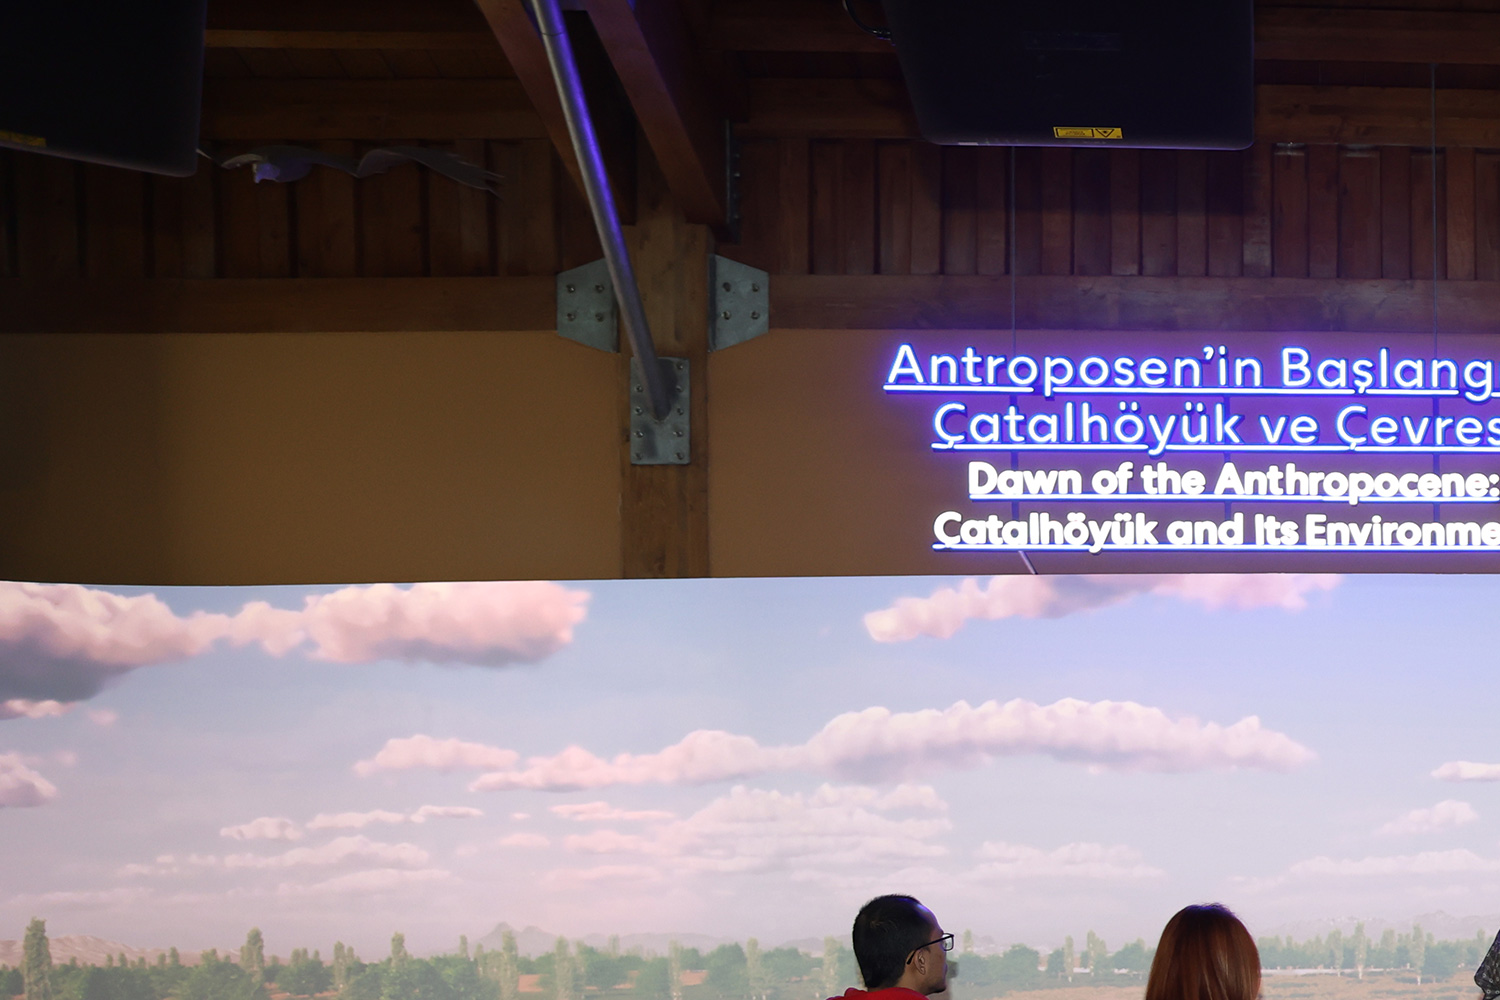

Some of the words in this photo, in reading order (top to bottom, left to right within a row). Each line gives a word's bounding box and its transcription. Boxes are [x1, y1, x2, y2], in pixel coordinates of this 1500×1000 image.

[932, 401, 1245, 456] Çatalhöyük
[1257, 414, 1319, 446] ve
[967, 460, 1083, 496] Dawn
[1090, 460, 1134, 496] of
[1139, 461, 1208, 496] the
[1212, 461, 1500, 507] Anthropocene:
[932, 510, 1160, 554] Çatalhöyük
[1165, 511, 1245, 547] and
[1253, 513, 1300, 547] Its
